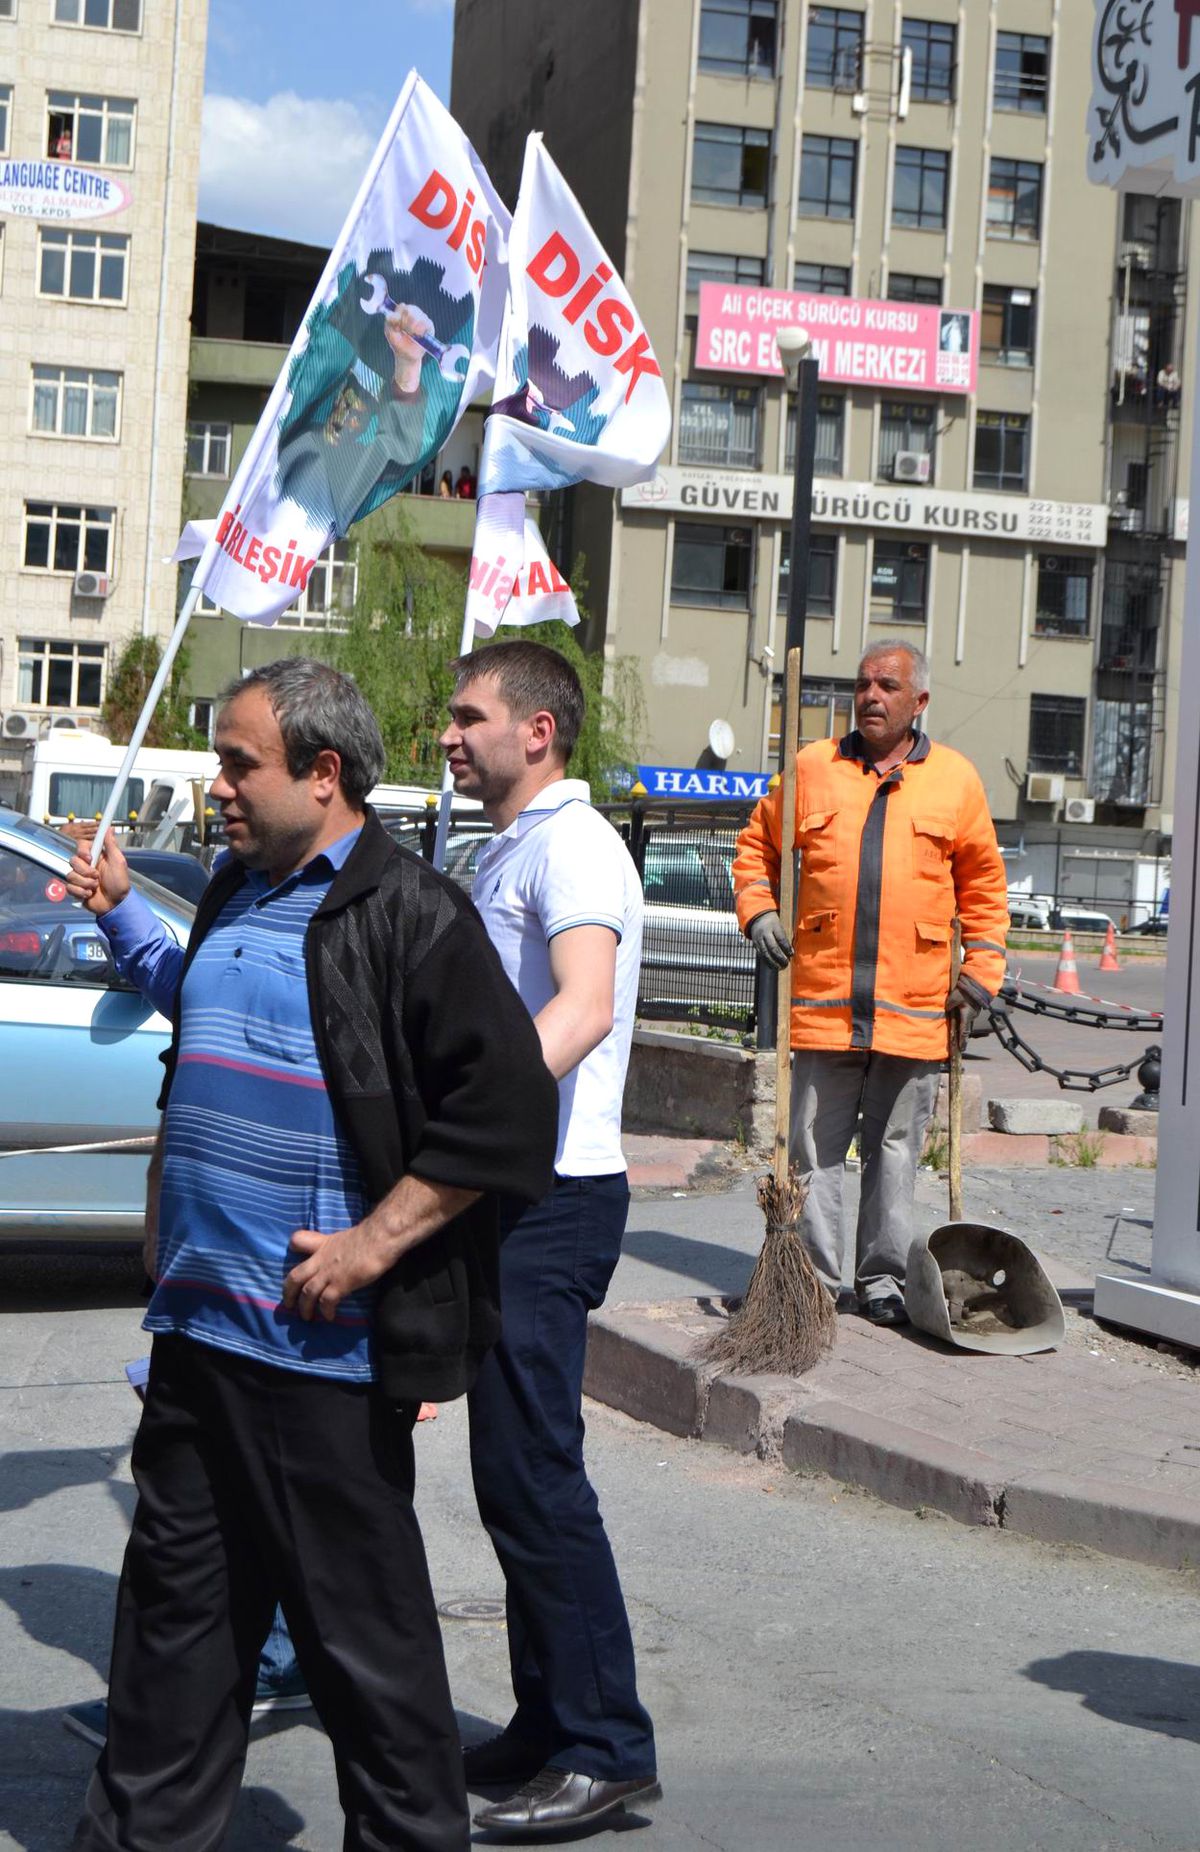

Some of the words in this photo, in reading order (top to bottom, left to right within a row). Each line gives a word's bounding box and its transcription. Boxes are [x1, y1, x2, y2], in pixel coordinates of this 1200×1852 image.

[63, 168, 110, 199] CENTRE
[746, 292, 793, 322] ÇİÇEK
[797, 299, 860, 328] SÜRÜCÜ
[865, 308, 919, 333] KURSU
[709, 328, 751, 366] SRC
[680, 482, 780, 512] GÜVEN
[811, 490, 912, 523] ÜRÜCÜ
[923, 505, 1019, 533] KURSU
[1028, 514, 1052, 525] 222
[1029, 502, 1053, 512] 222
[1076, 507, 1093, 517] 22
[1027, 527, 1052, 537] 222
[654, 772, 770, 797] HARM
